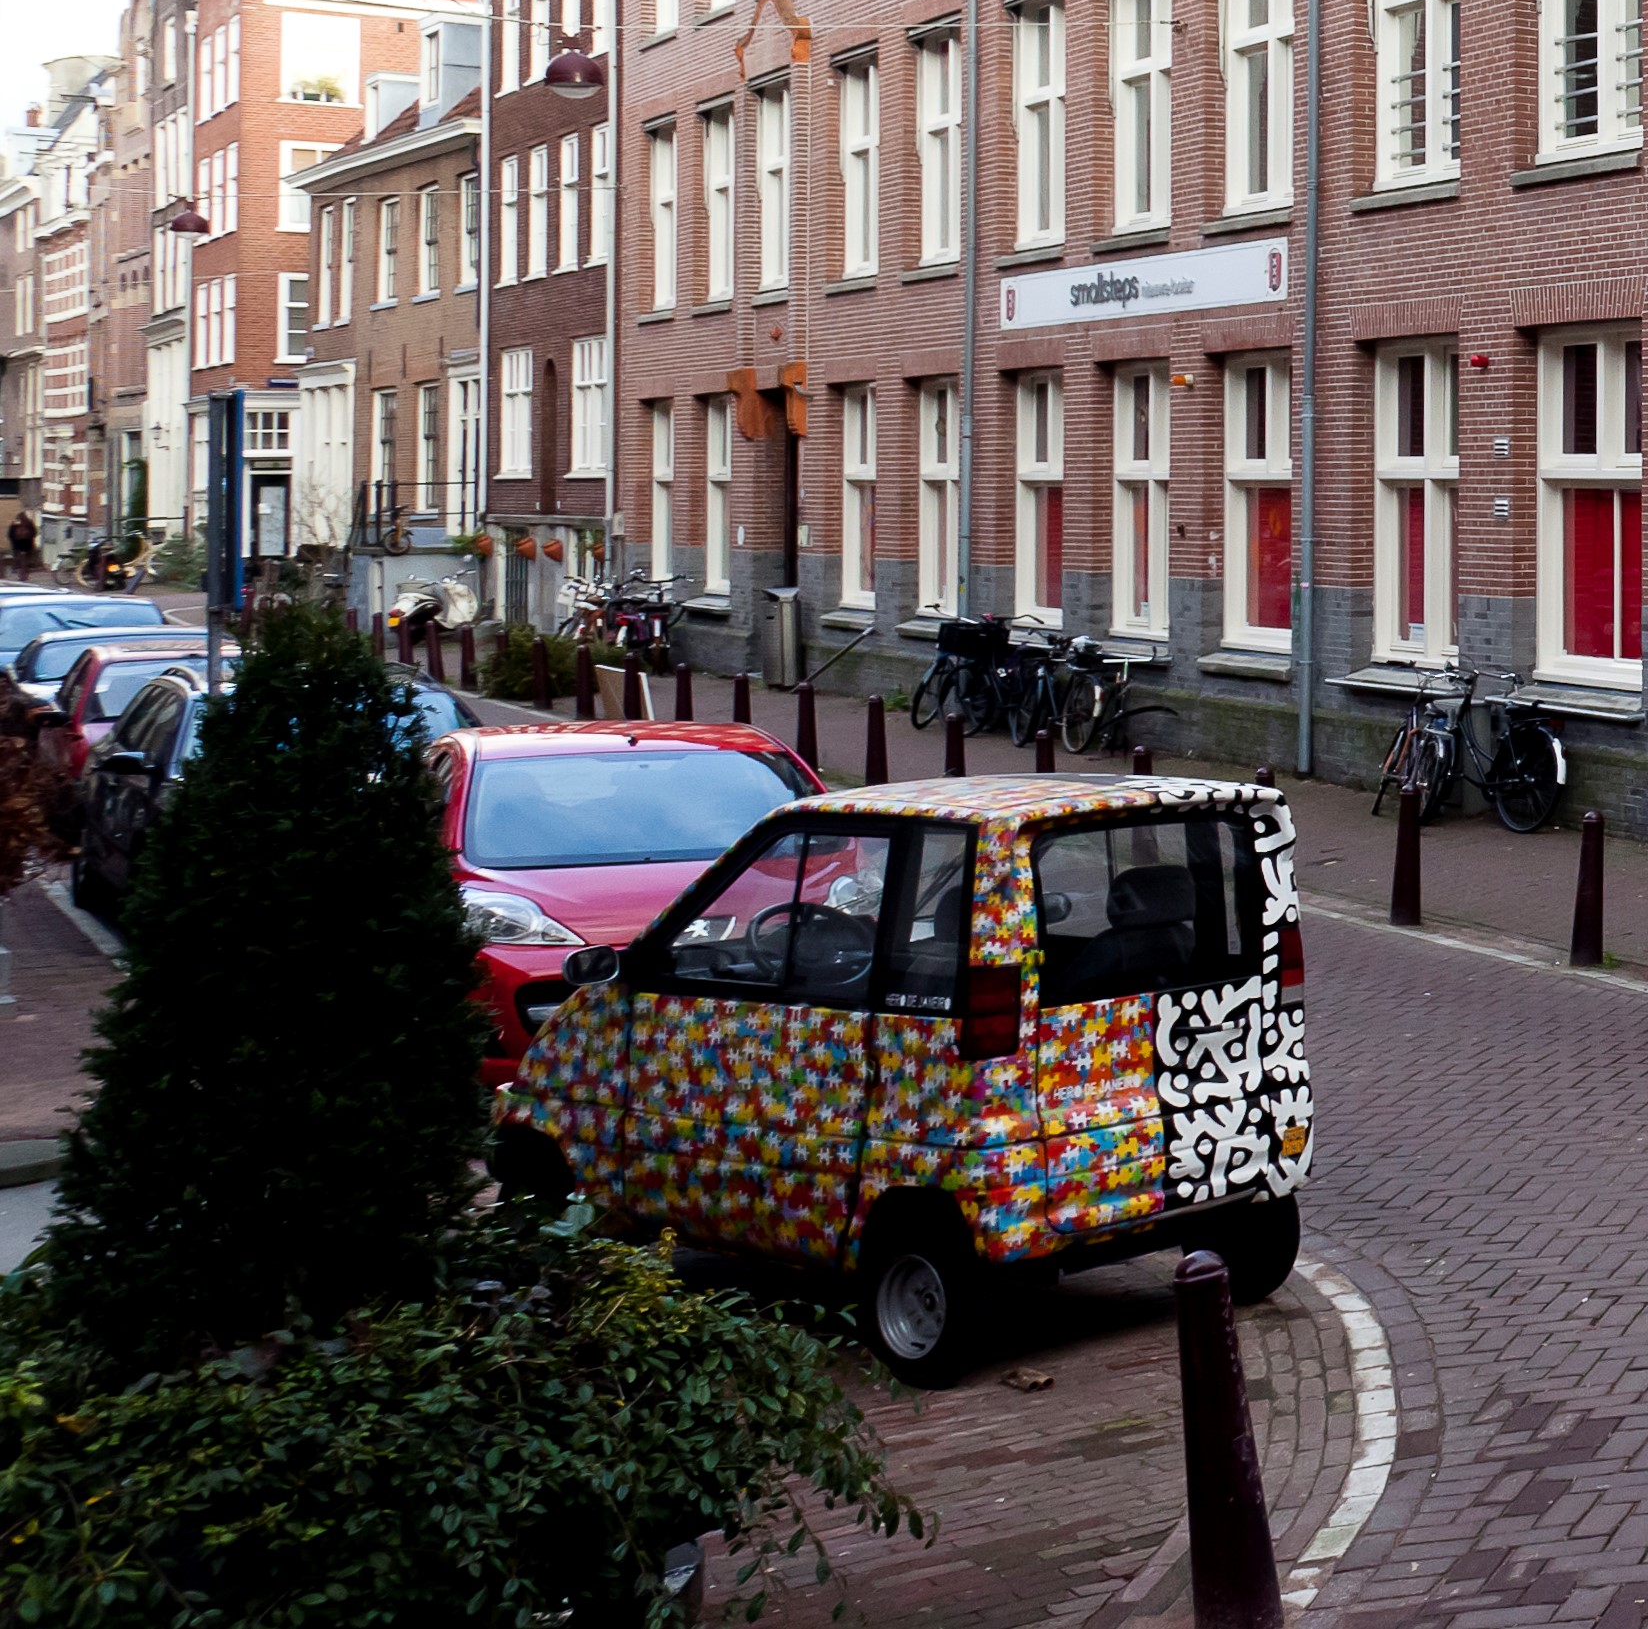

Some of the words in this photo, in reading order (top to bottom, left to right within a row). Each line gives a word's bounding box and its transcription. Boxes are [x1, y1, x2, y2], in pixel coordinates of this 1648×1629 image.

[1069, 270, 1140, 309] smallsteps
[885, 993, 906, 1007] HERO
[907, 994, 918, 1008] DE
[1053, 1085, 1083, 1101] HERO
[1084, 1081, 1097, 1096] DE
[1098, 1074, 1141, 1094] JANEIRO
